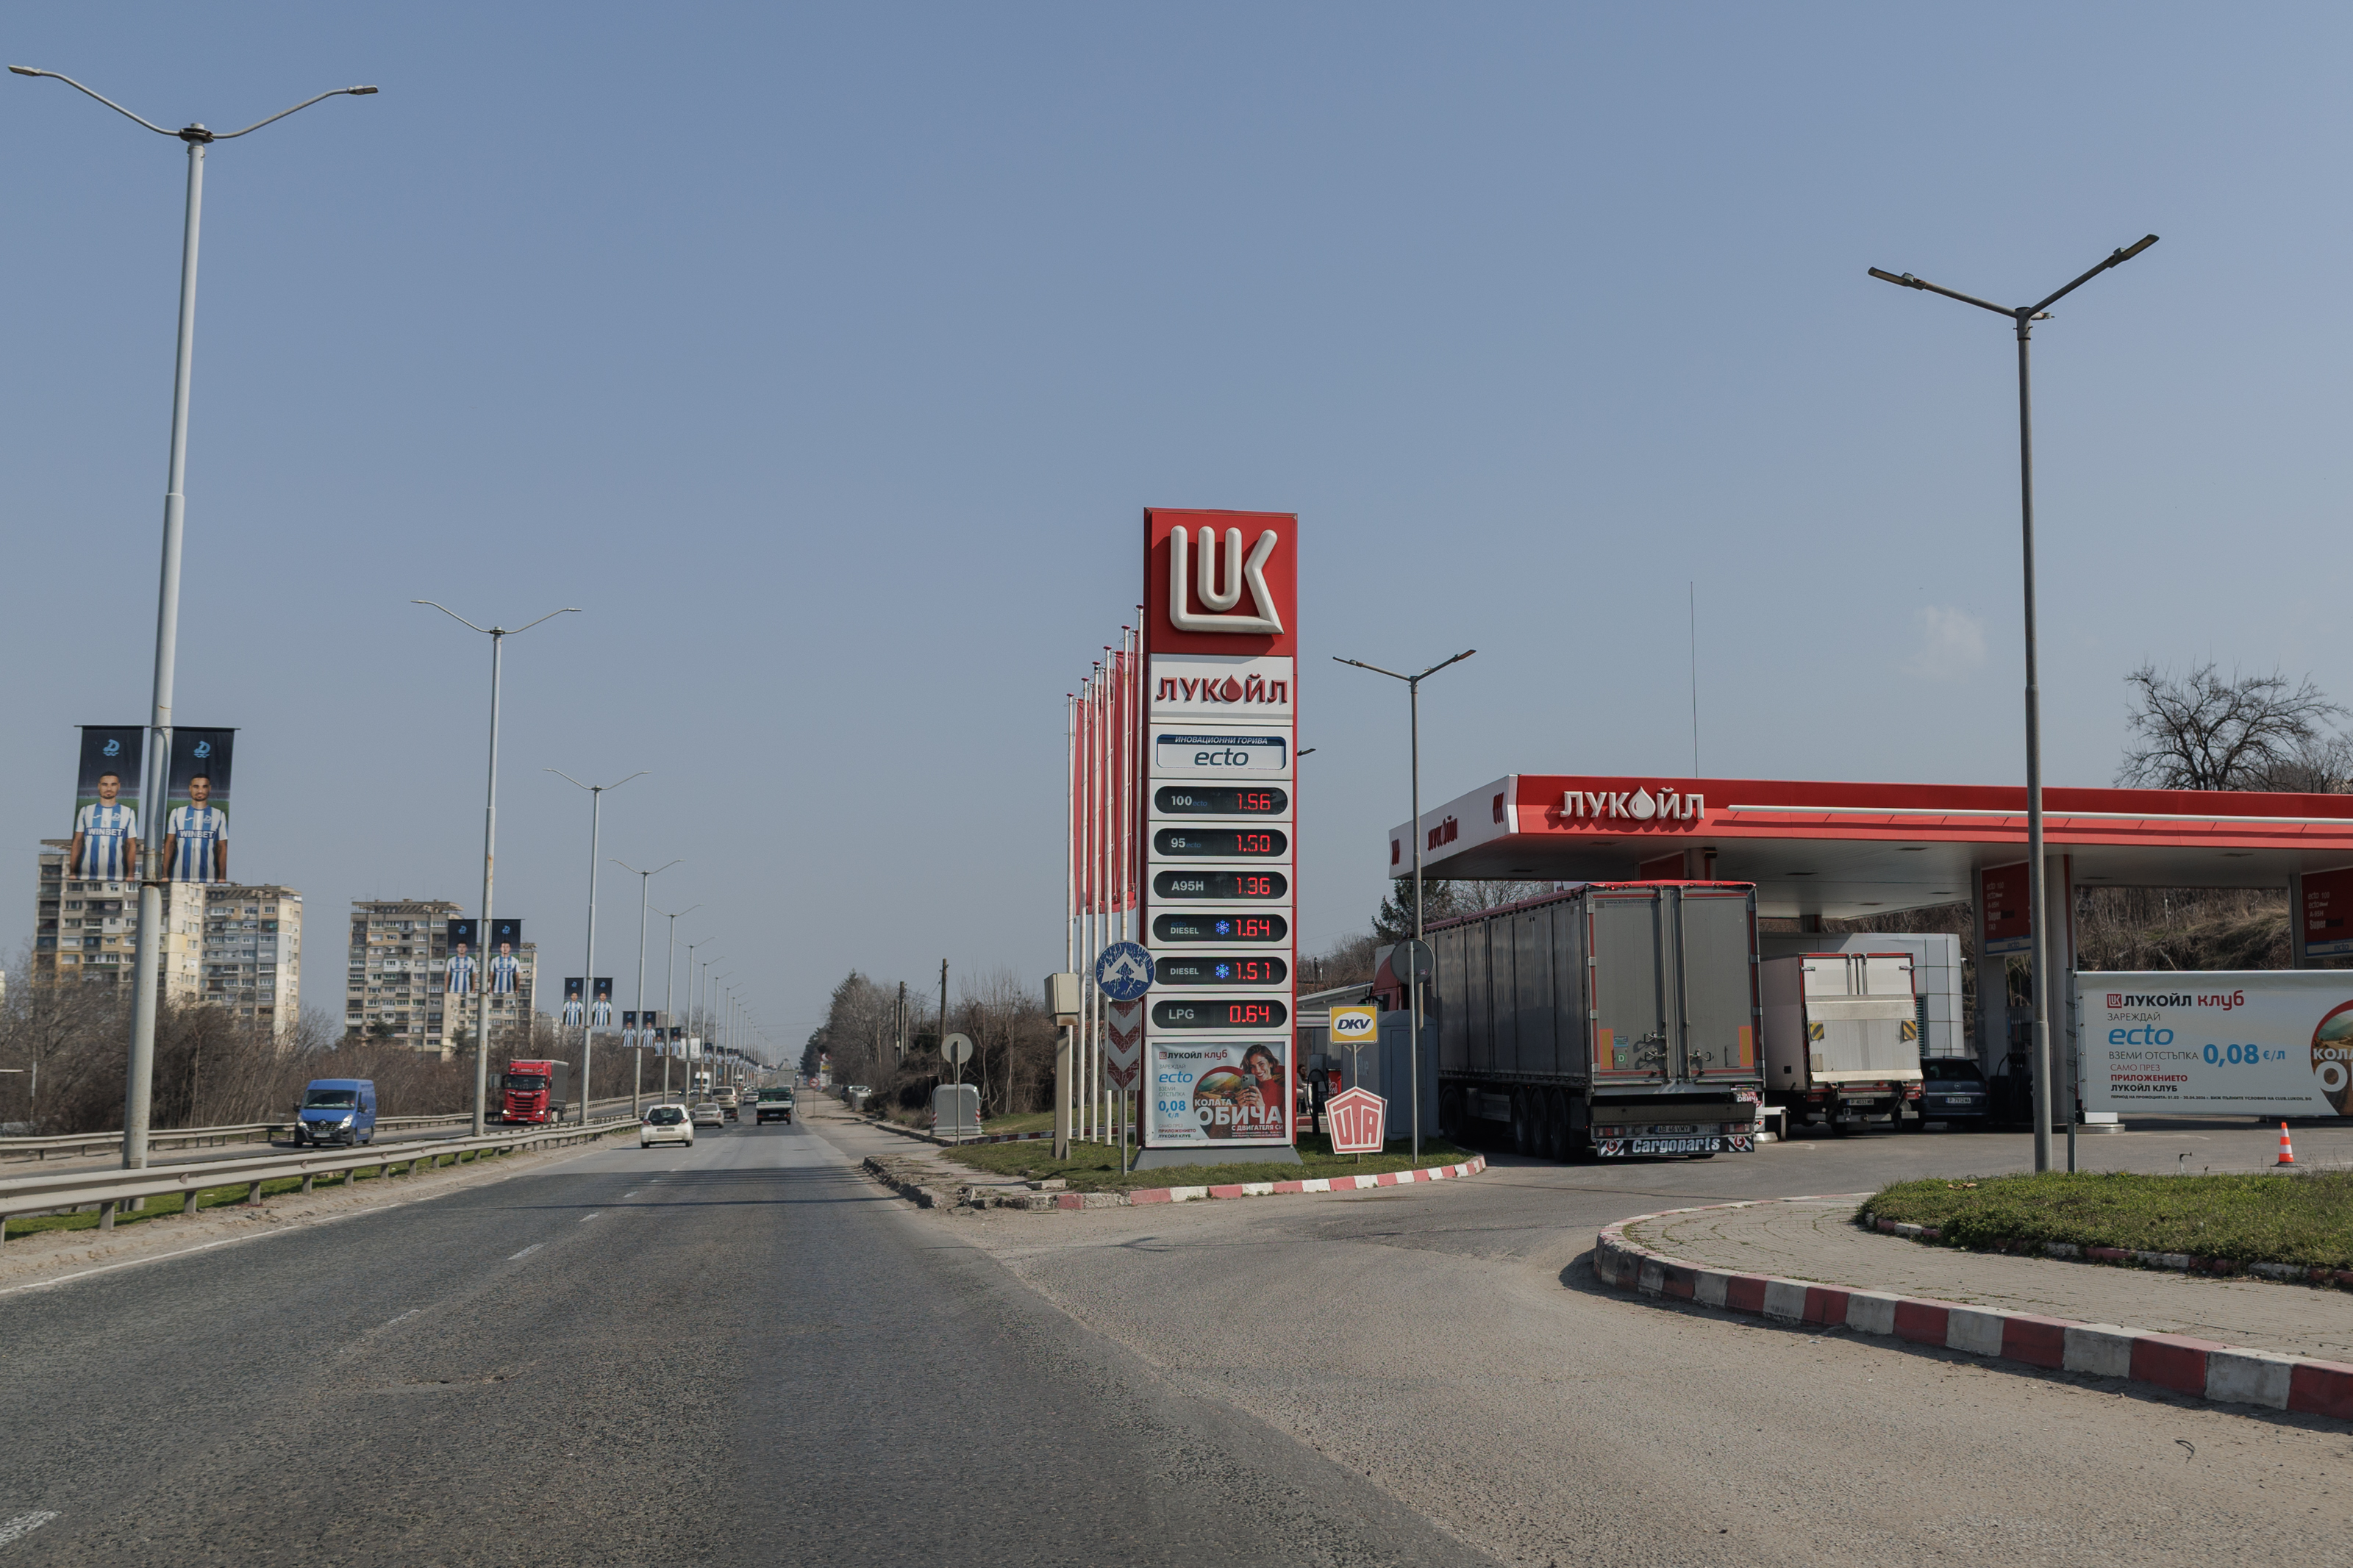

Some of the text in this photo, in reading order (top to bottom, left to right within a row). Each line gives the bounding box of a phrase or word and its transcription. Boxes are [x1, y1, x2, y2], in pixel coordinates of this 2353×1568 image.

[1175, 736, 1236, 745] ИНОВАЦИОННИ
[1194, 748, 1249, 766] ecto
[1171, 795, 1193, 806] 100
[1237, 793, 1271, 810] 1.56
[88, 828, 124, 837] WINBET
[179, 830, 215, 838] WINBET
[1171, 837, 1186, 848] 95
[1237, 835, 1271, 852] 1.50
[1237, 877, 1271, 895] 1.36
[1236, 919, 1270, 937] 1.64
[2334, 943, 2349, 951] ecto
[1236, 962, 1270, 980] 1.51
[2124, 992, 2192, 1007] ЛУКОЙЛ
[2197, 989, 2245, 1011] клуб
[1168, 1006, 1269, 1023] LPG 0.64
[2107, 1012, 2160, 1022] ЗАРЕЖДАЙ
[1338, 1019, 1371, 1030] DKV
[2108, 1024, 2174, 1045] ecto
[1204, 1049, 1227, 1060] клуб
[2109, 1051, 2142, 1060] ВЗЕМИ
[2145, 1051, 2199, 1060] ОТСТЪПКА
[2203, 1044, 2260, 1067] 0,08
[2139, 1064, 2160, 1072] ПРЕЗ
[1159, 1071, 1193, 1083] ecto
[2110, 1074, 2188, 1082] ПРИЛОЖЕНИЕТО
[2110, 1084, 2151, 1092] ЛУКОЙЛ
[1158, 1100, 1186, 1113] 0,08
[1194, 1098, 1232, 1106] КОЛАТА
[1195, 1106, 1283, 1126] ОБИЧА
